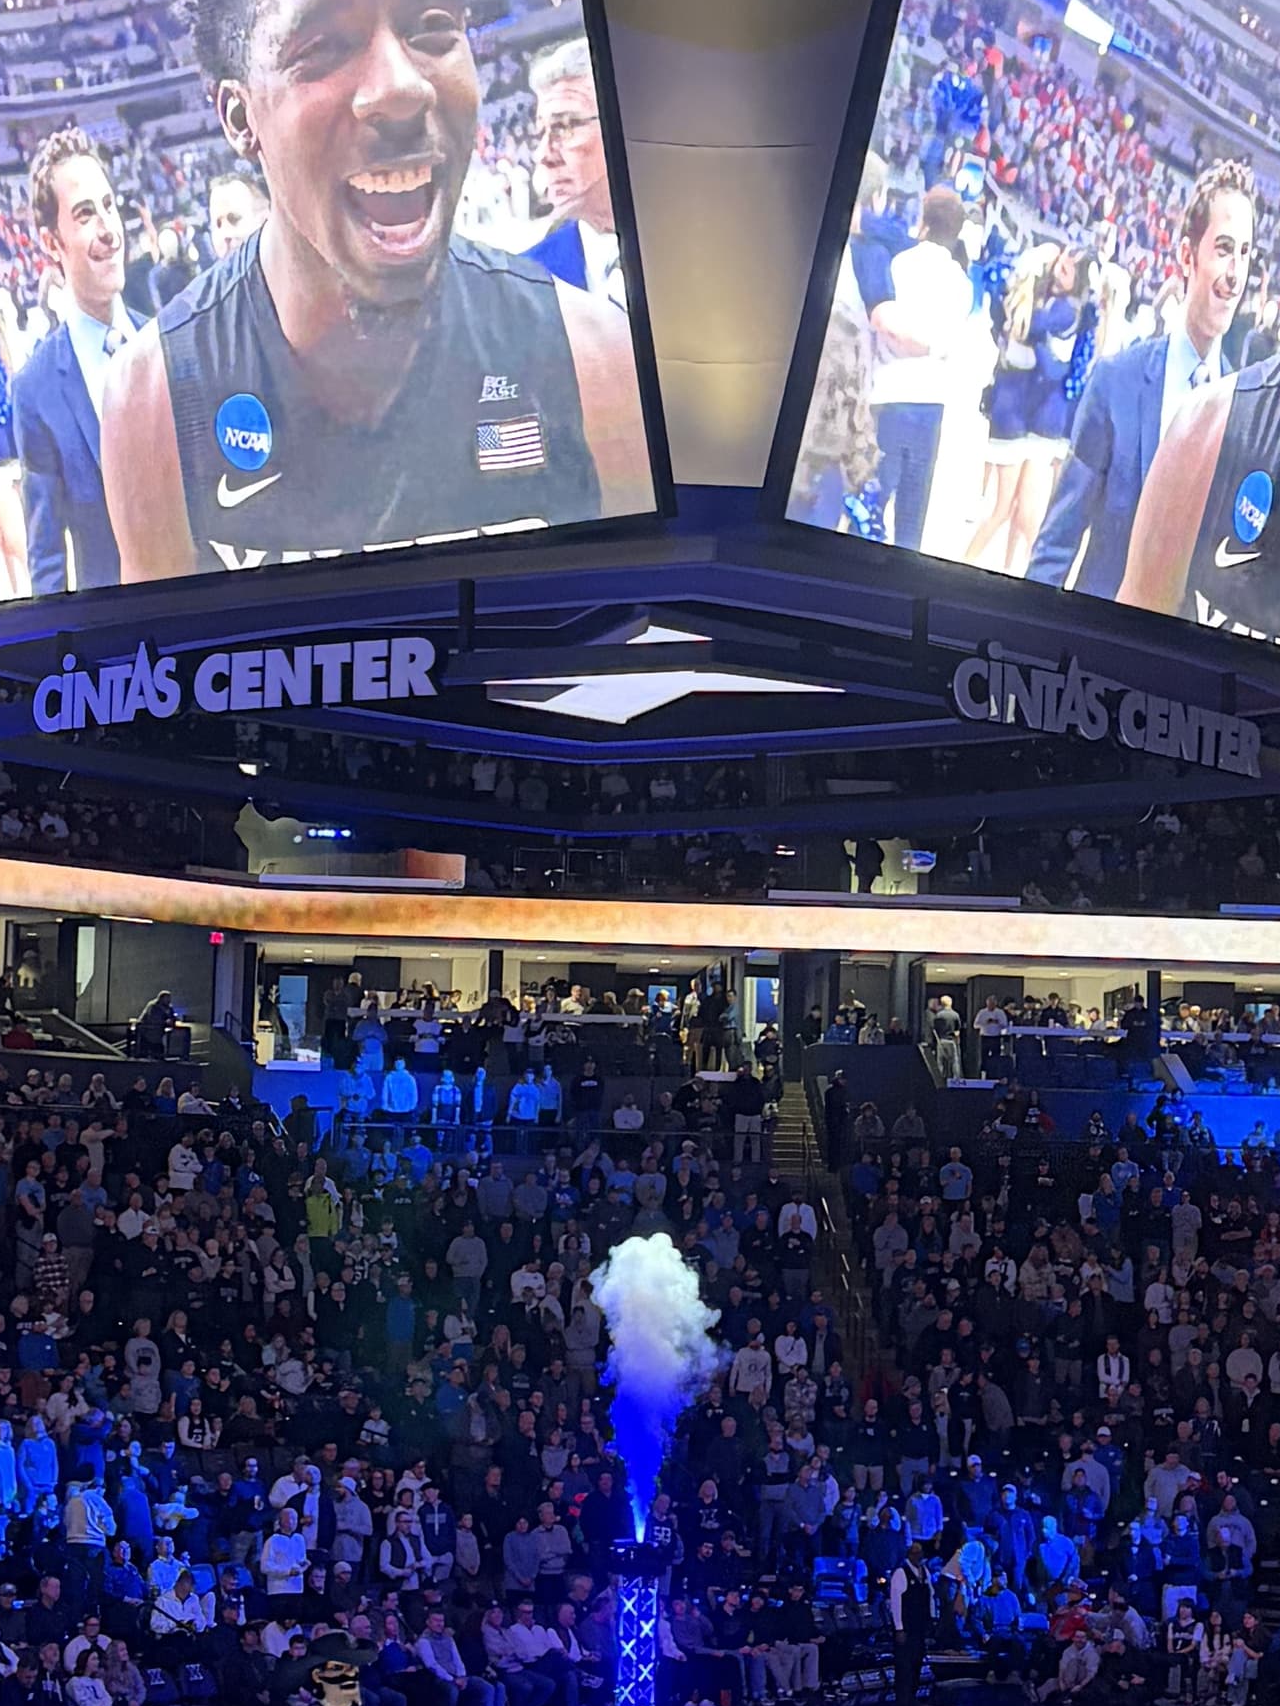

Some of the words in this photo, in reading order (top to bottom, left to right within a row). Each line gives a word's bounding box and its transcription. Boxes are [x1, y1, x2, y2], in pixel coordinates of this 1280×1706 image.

[223, 426, 270, 454] NCAA
[193, 636, 439, 713] CENTER
[1117, 688, 1262, 779] CENTER
